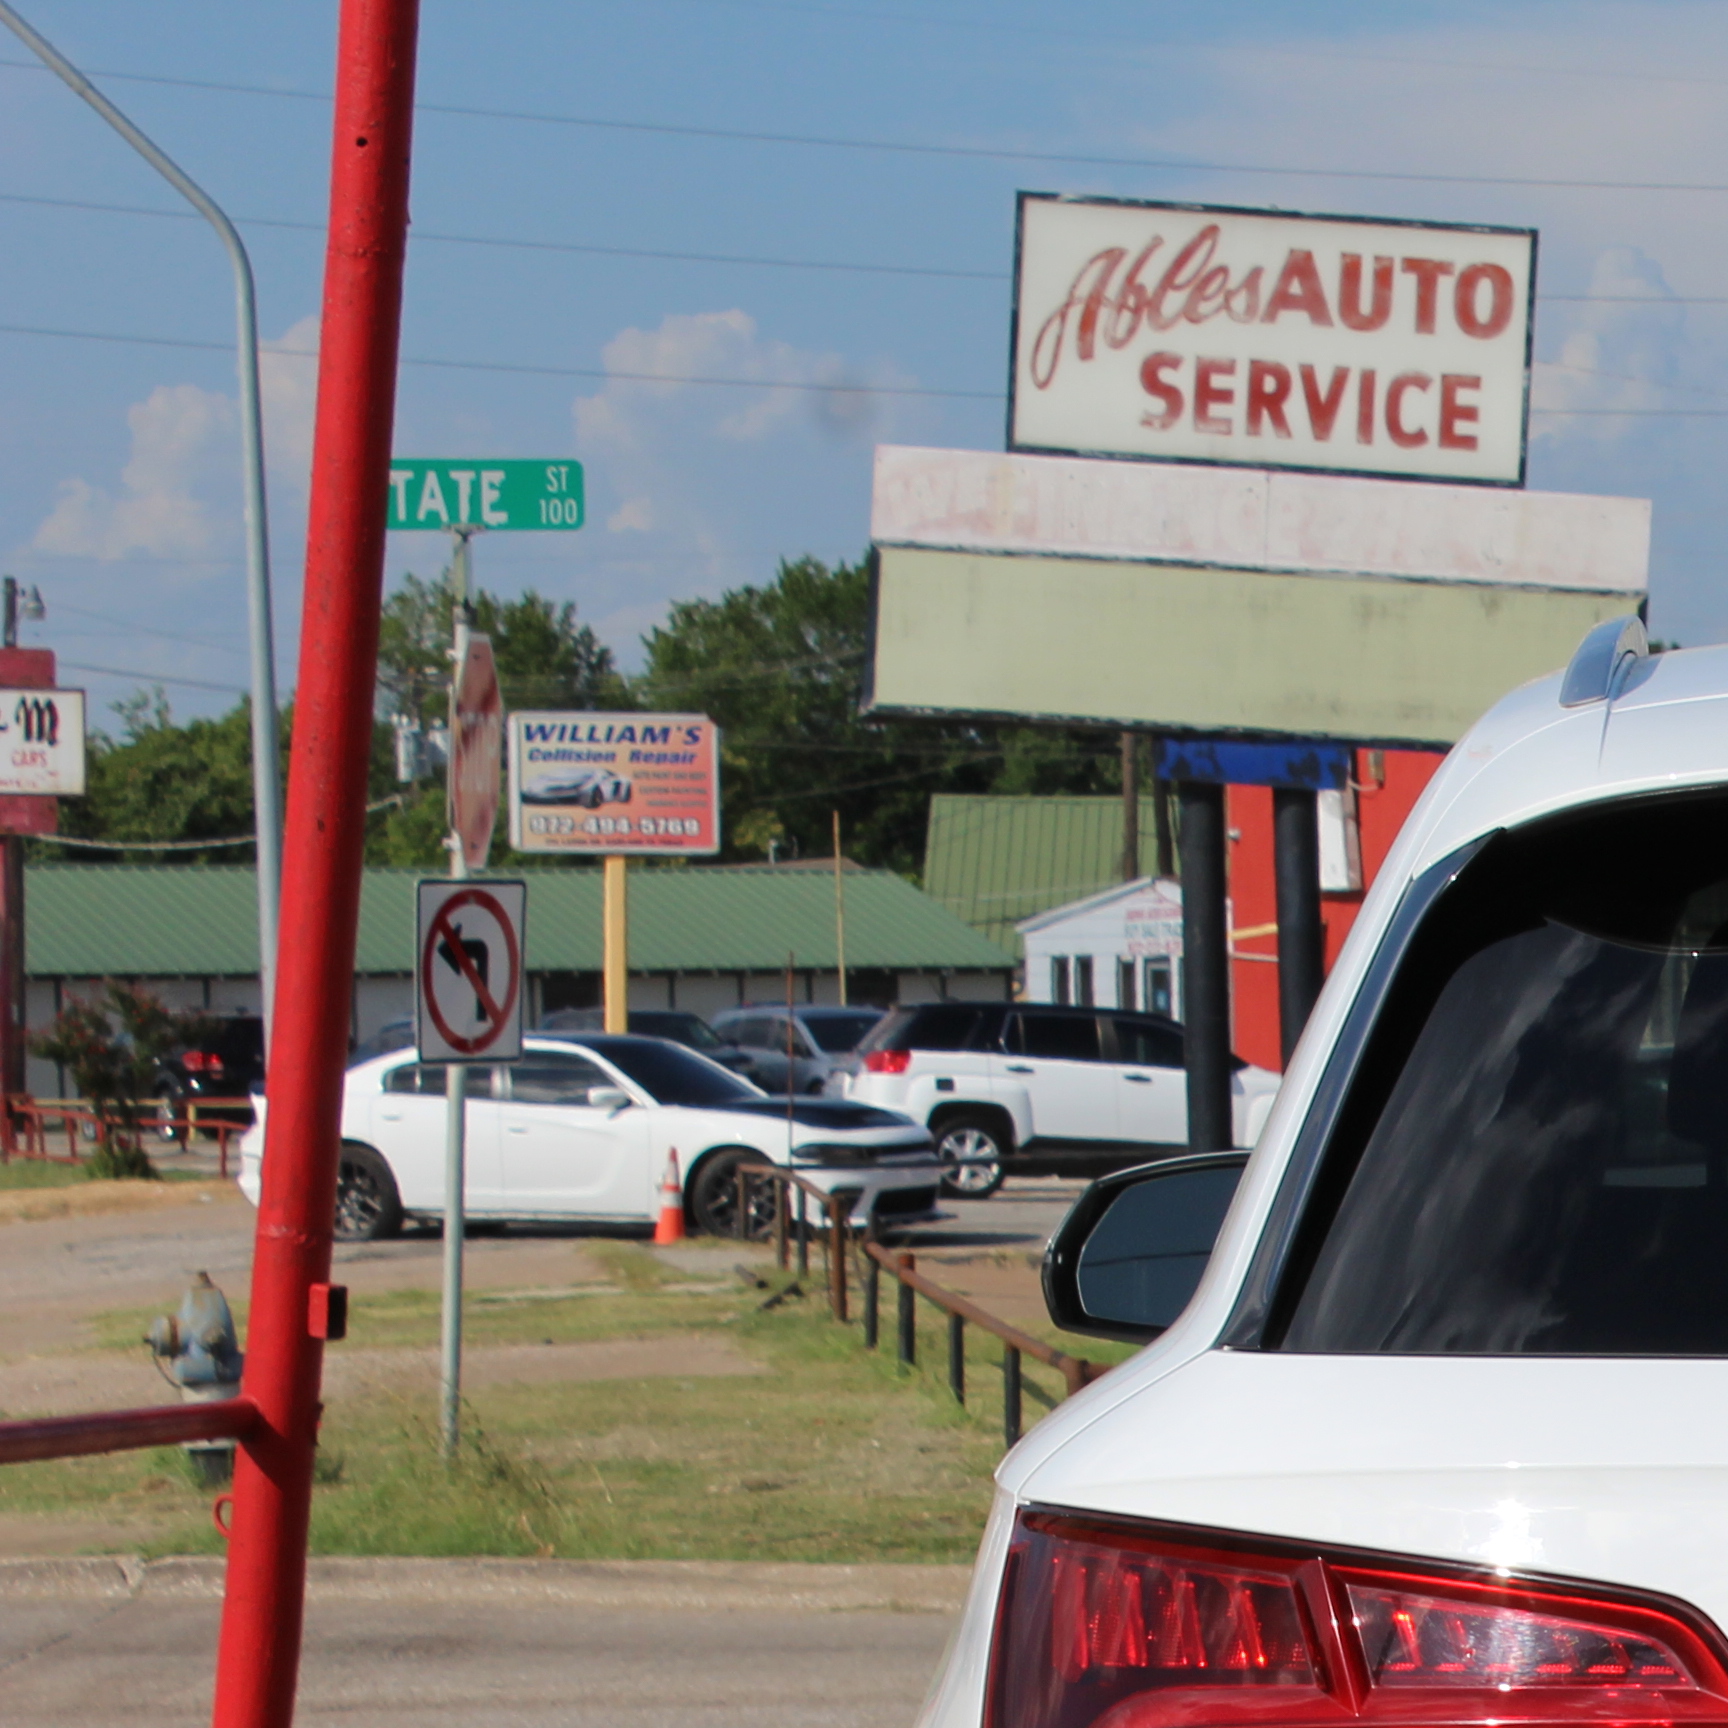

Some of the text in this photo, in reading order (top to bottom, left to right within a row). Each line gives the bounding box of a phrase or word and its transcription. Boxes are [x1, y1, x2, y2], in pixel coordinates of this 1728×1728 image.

[1030, 224, 1515, 390] Ables AUTO
[1138, 350, 1483, 451] SERVICE
[545, 465, 570, 493] ST
[539, 498, 578, 525] 100
[523, 723, 703, 746] WILLIAM'S
[528, 747, 698, 764] Collision Repair
